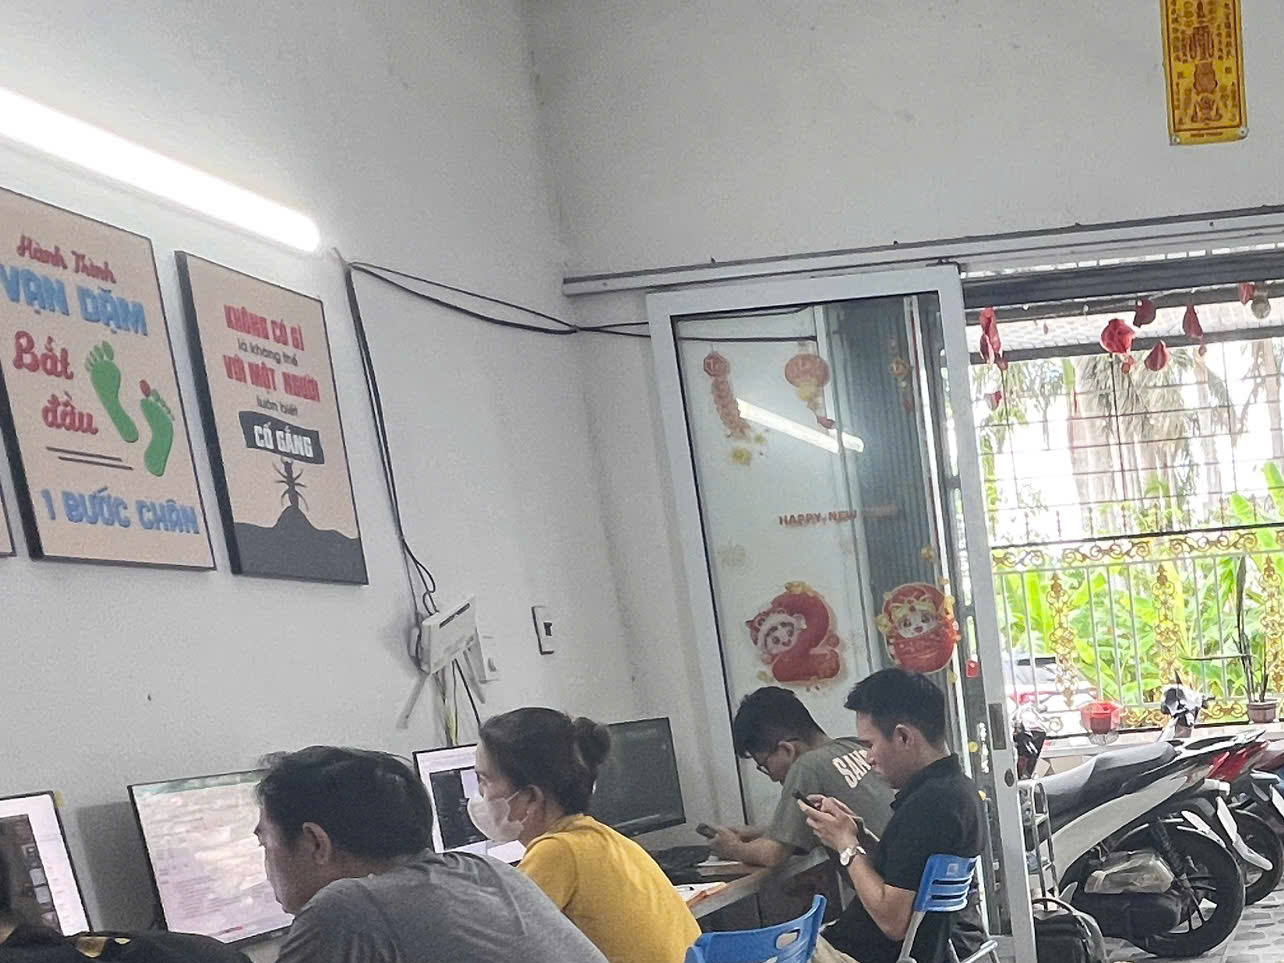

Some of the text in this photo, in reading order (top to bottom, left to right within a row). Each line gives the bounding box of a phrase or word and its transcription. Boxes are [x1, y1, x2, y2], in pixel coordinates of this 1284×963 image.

[0, 263, 70, 316] VẠN
[253, 421, 314, 458] CỐ GẮNG
[40, 485, 201, 535] 1 BƯỚC CHÂN
[779, 511, 821, 526] HAPPY
[827, 509, 857, 521] NEW
[832, 749, 872, 789] SAN
